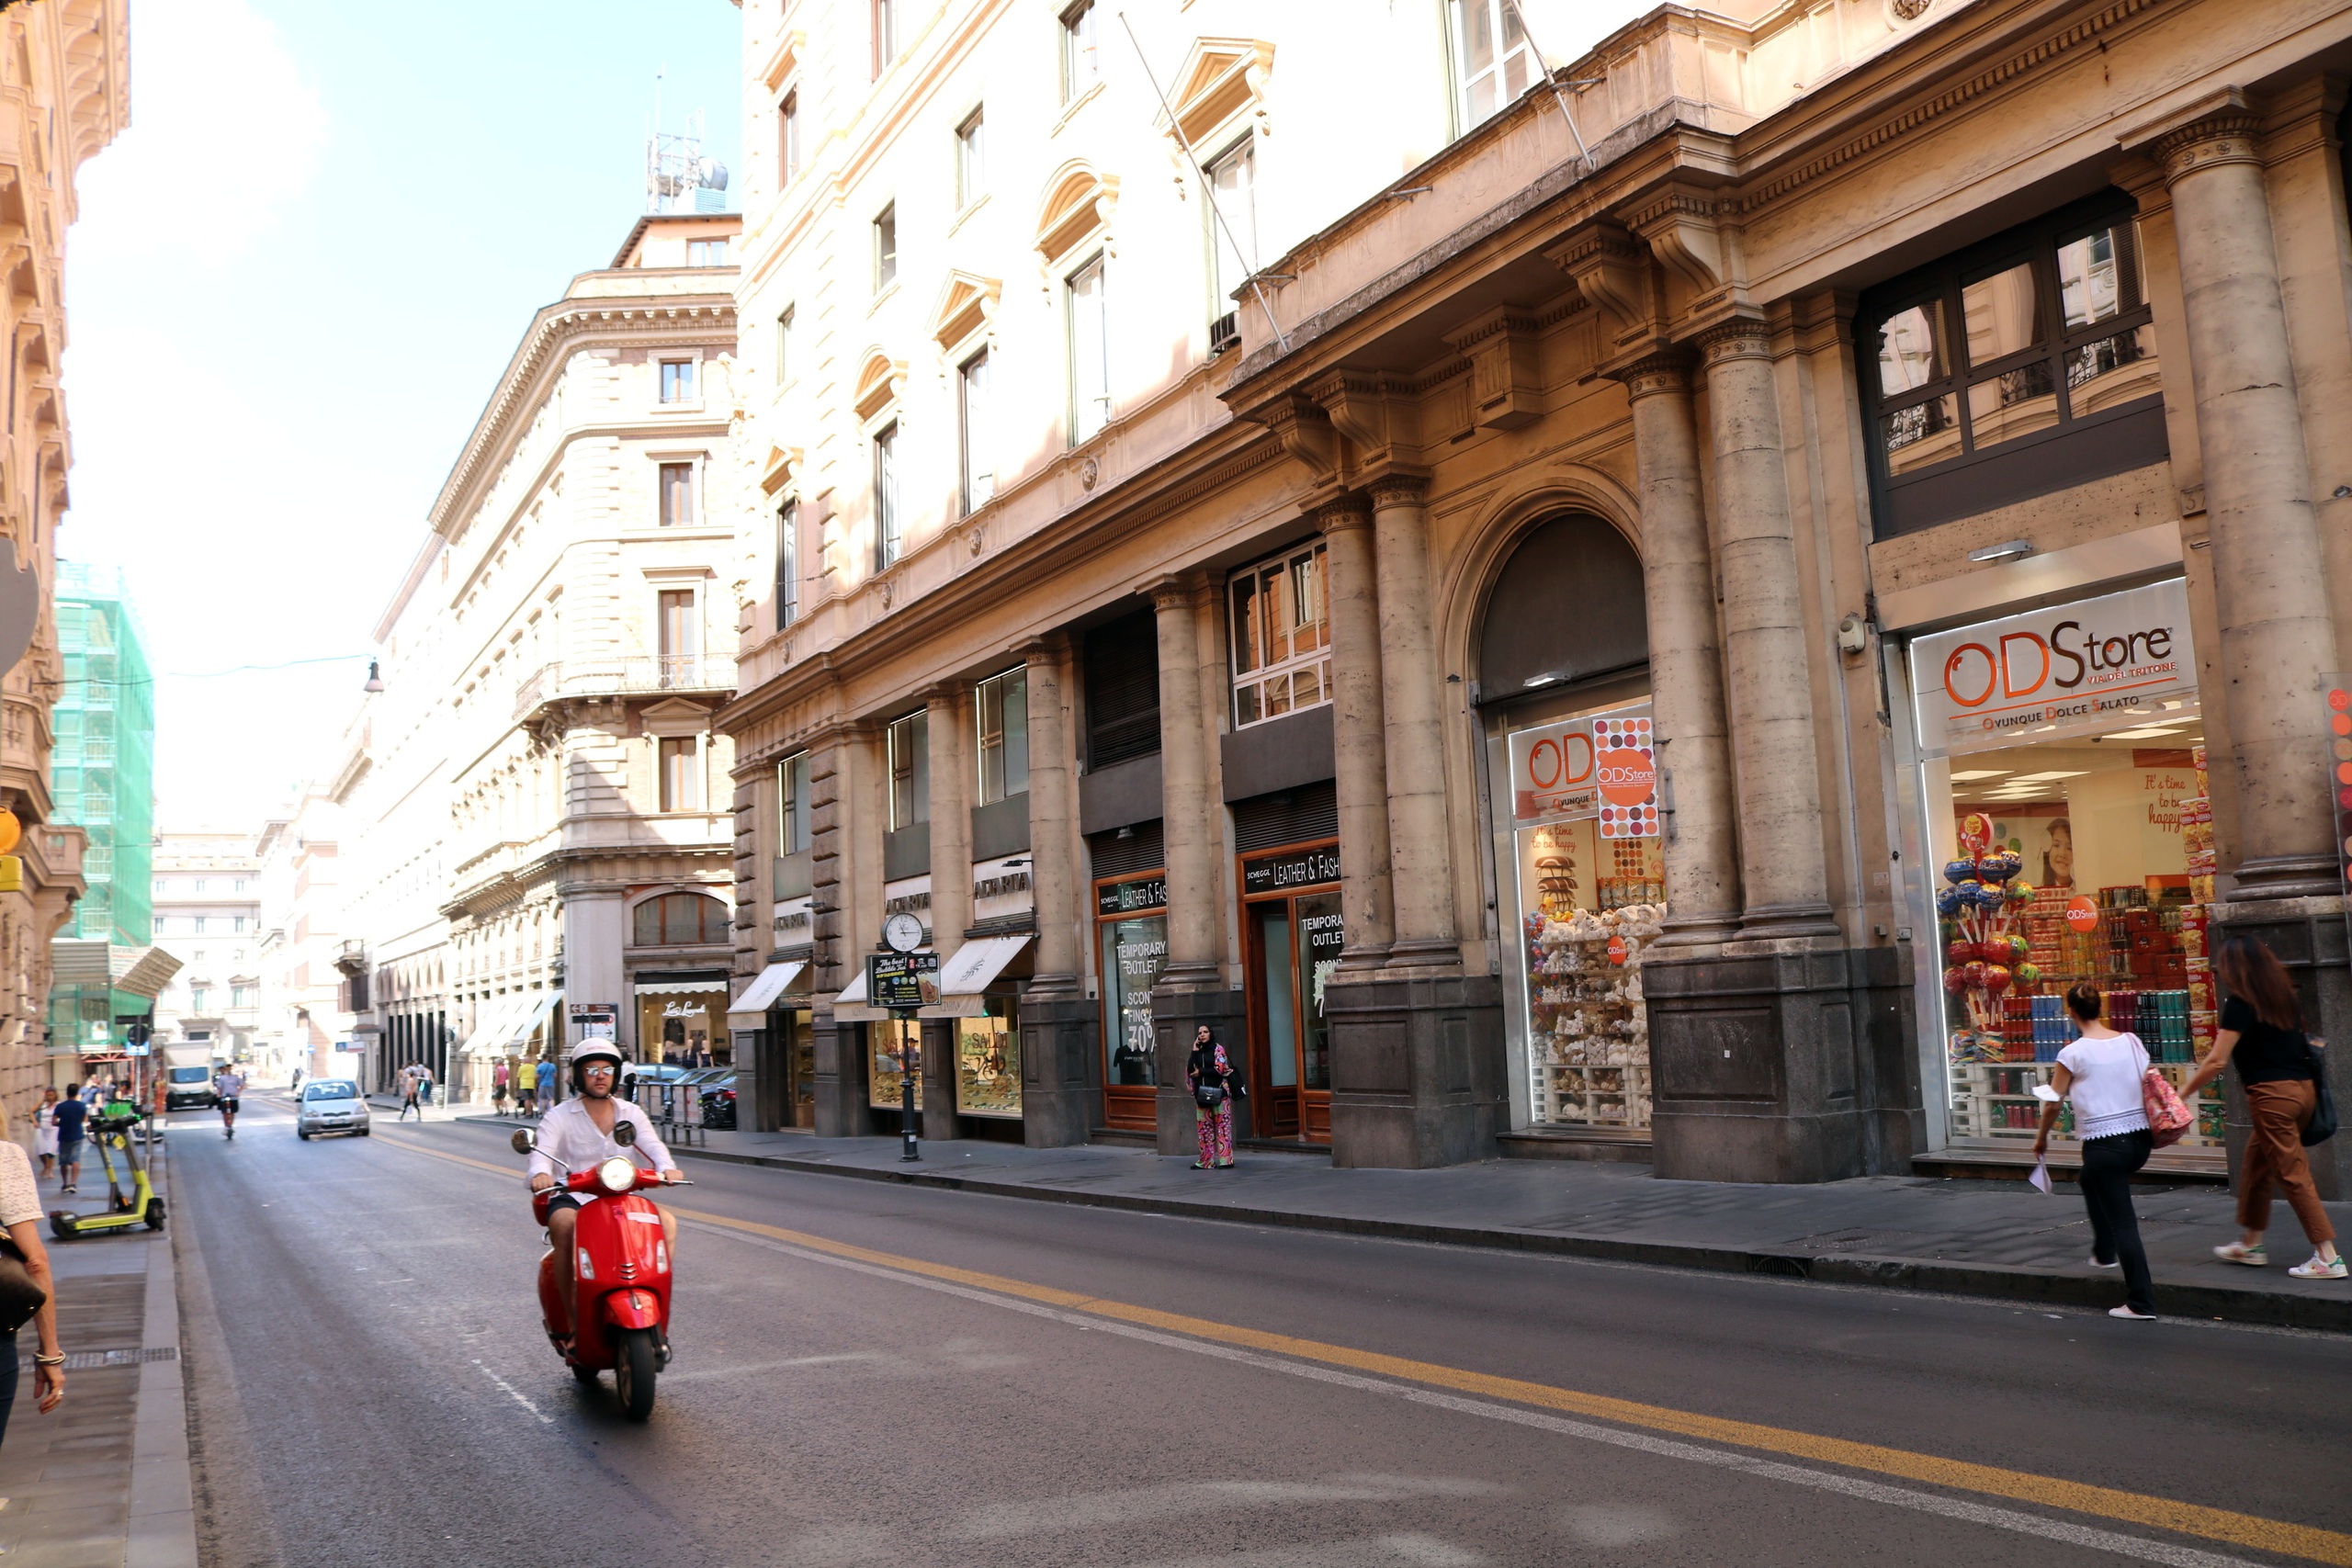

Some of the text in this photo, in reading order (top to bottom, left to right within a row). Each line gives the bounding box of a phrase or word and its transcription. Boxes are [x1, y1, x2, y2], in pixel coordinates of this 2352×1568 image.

[1944, 621, 2173, 706] ODStore
[2086, 661, 2177, 685] VIA DEL TRITONE
[1983, 696, 2139, 730] OVUNQUE DOLCE SALATO
[1598, 767, 1654, 783] ODStore
[2144, 774, 2186, 790] It's time
[1553, 795, 1590, 808] OVUNQUE
[2159, 793, 2169, 808] to
[2148, 804, 2181, 834] happy
[1554, 823, 1574, 836] time
[1531, 836, 1577, 853] to be happy
[1273, 863, 1306, 886] LEATHER
[1307, 856, 1316, 881] &
[1121, 888, 1148, 908] LEATHER
[1148, 883, 1154, 905] &
[1116, 941, 1166, 958] TEMPORARY
[1126, 960, 1158, 975] OUTLET
[972, 1032, 1009, 1049] SALDI
